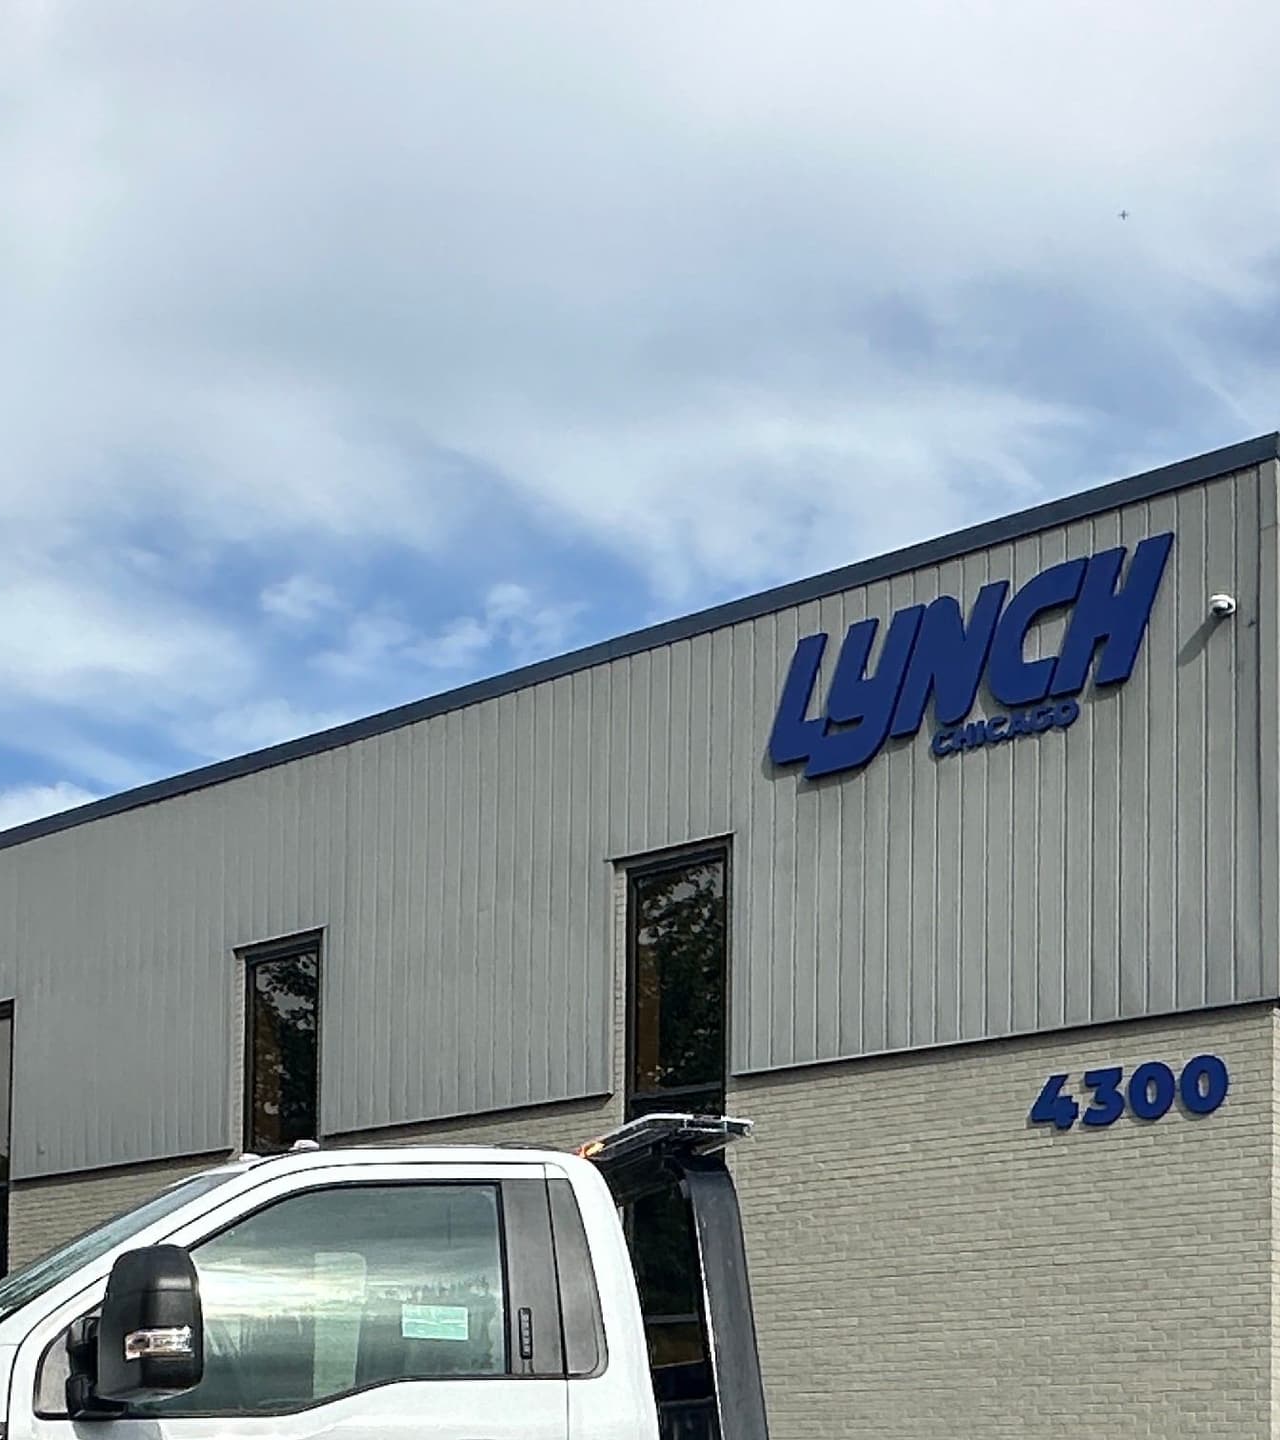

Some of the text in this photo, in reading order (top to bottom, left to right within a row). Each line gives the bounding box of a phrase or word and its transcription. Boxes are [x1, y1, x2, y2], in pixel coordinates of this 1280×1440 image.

[769, 532, 1175, 779] LYNCH
[931, 699, 1080, 757] CHICAGO
[1031, 1054, 1230, 1130] 4300
